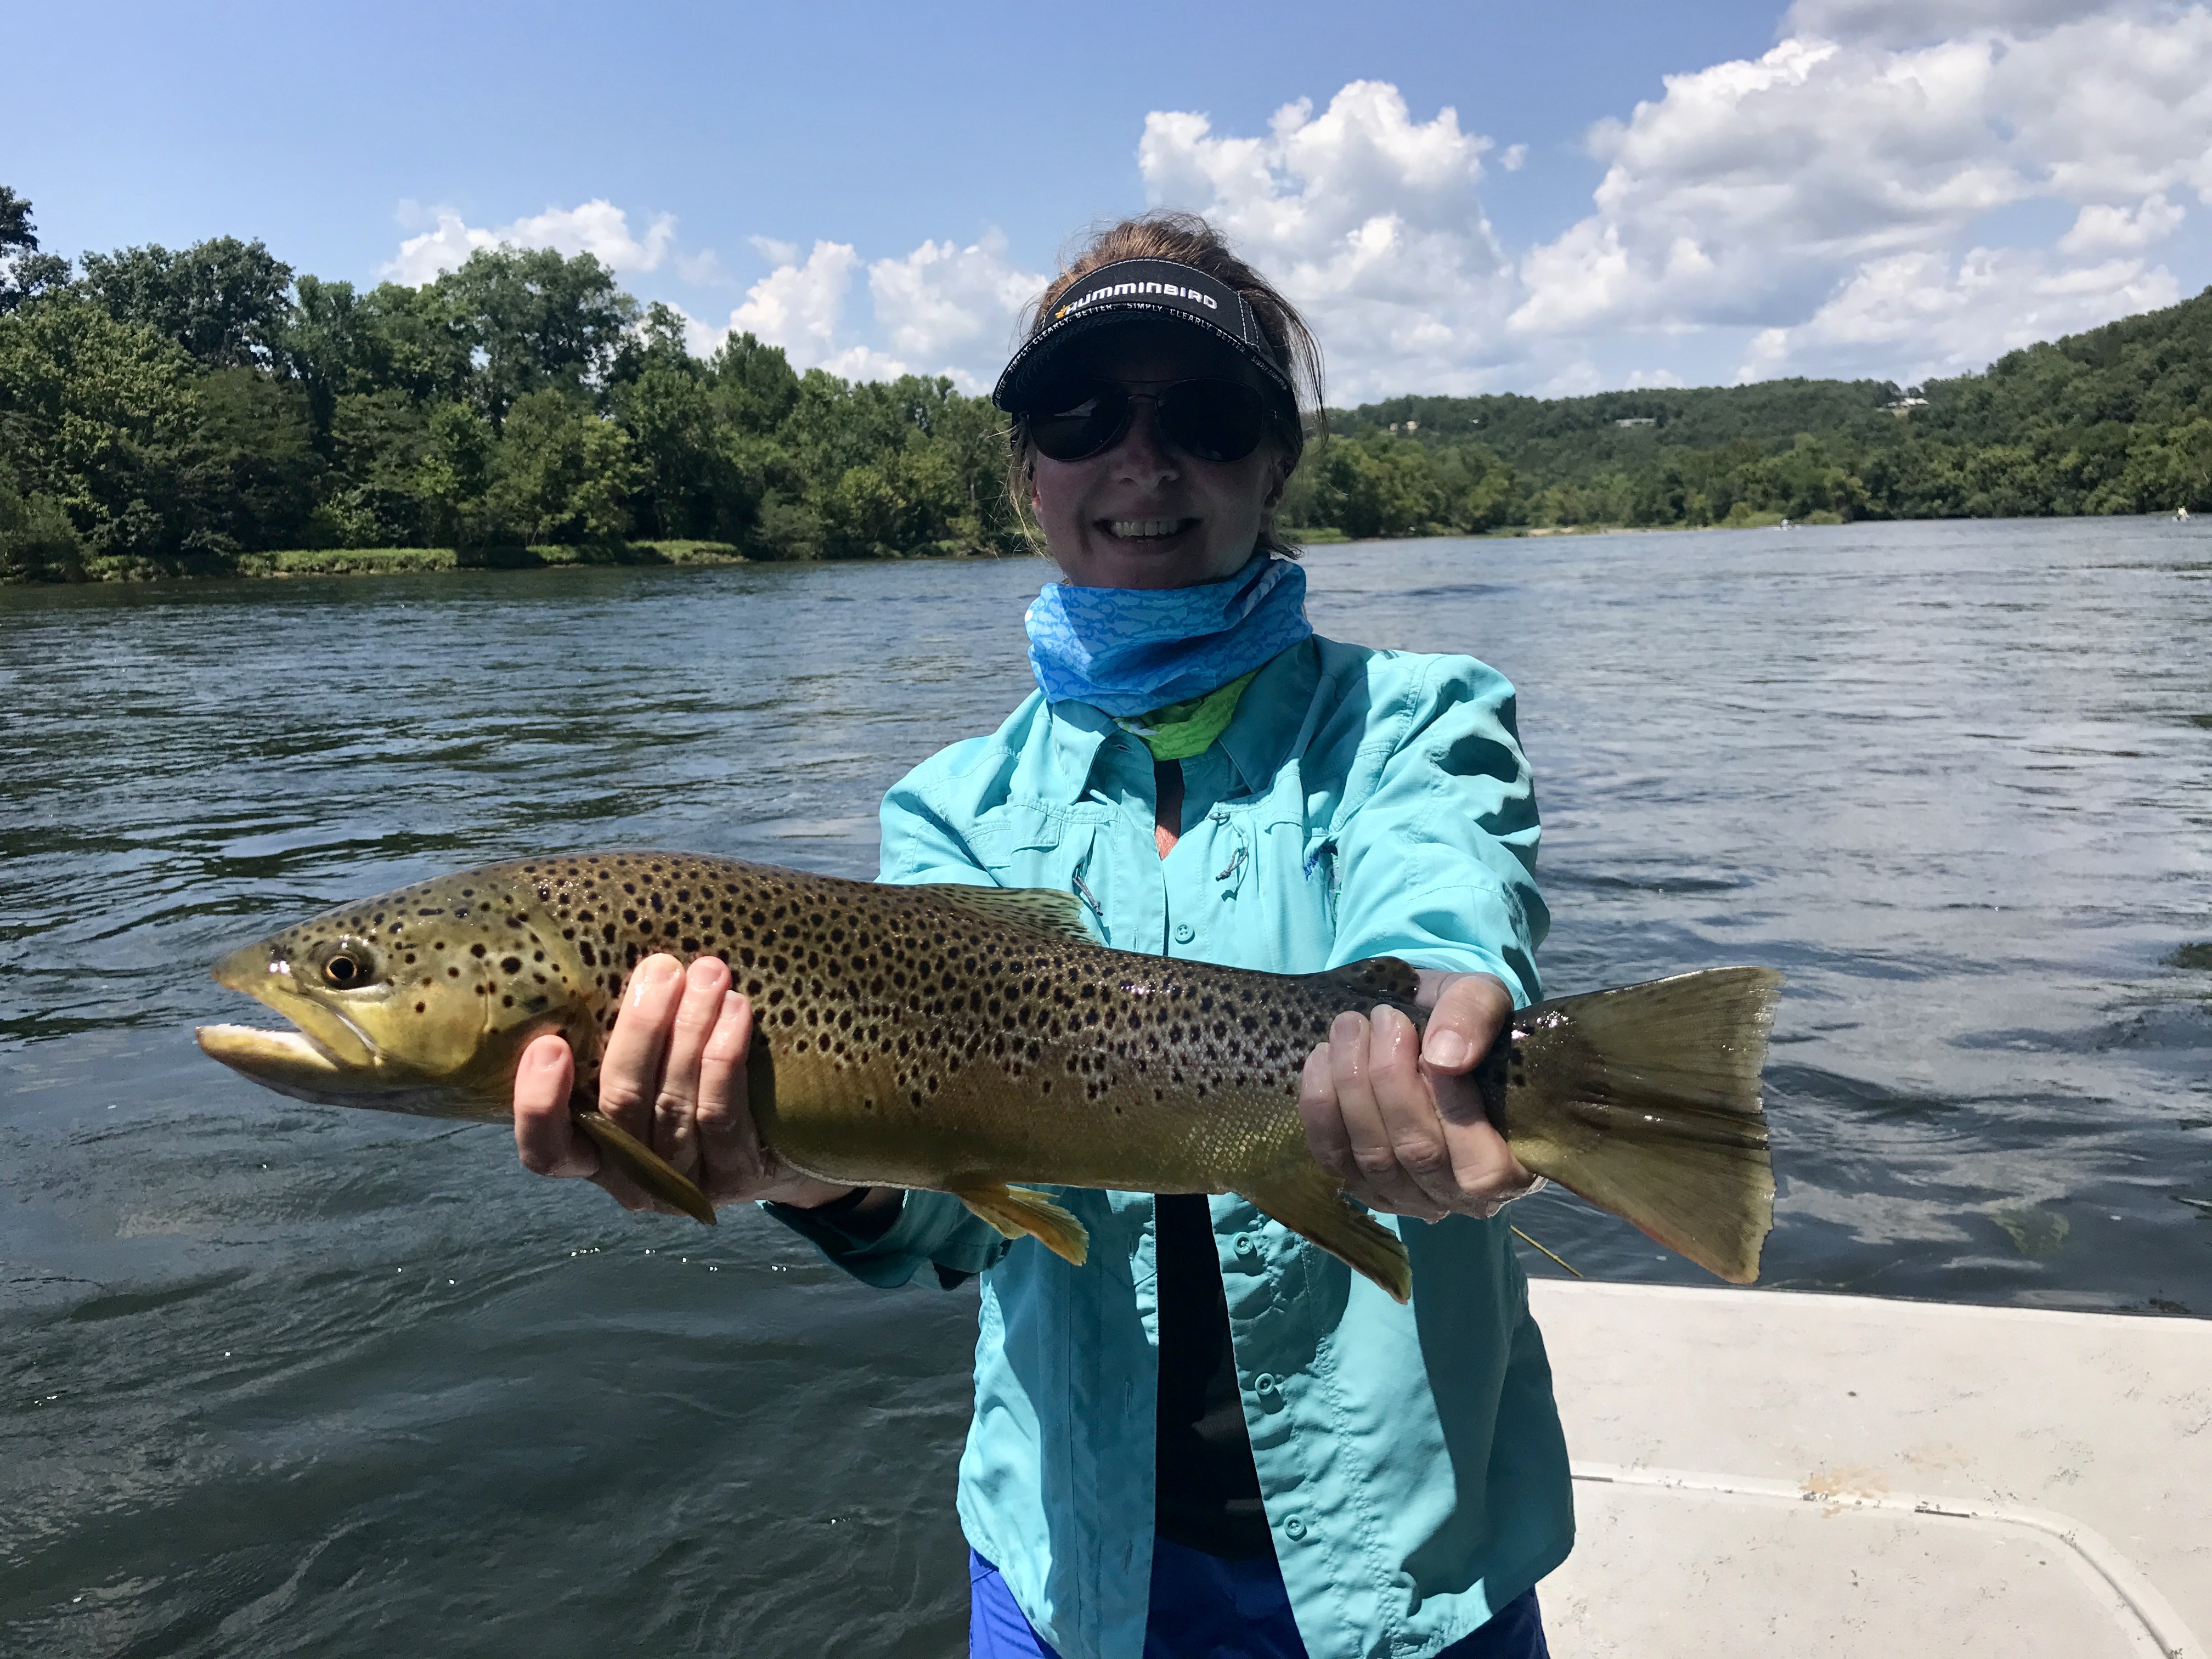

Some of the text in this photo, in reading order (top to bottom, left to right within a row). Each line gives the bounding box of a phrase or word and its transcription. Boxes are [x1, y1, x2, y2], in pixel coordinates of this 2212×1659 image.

[1065, 281, 1217, 315] HUMMINBIRD
[1032, 317, 1072, 345] CLEARLY.
[1170, 308, 1212, 332] CLEARLY.
